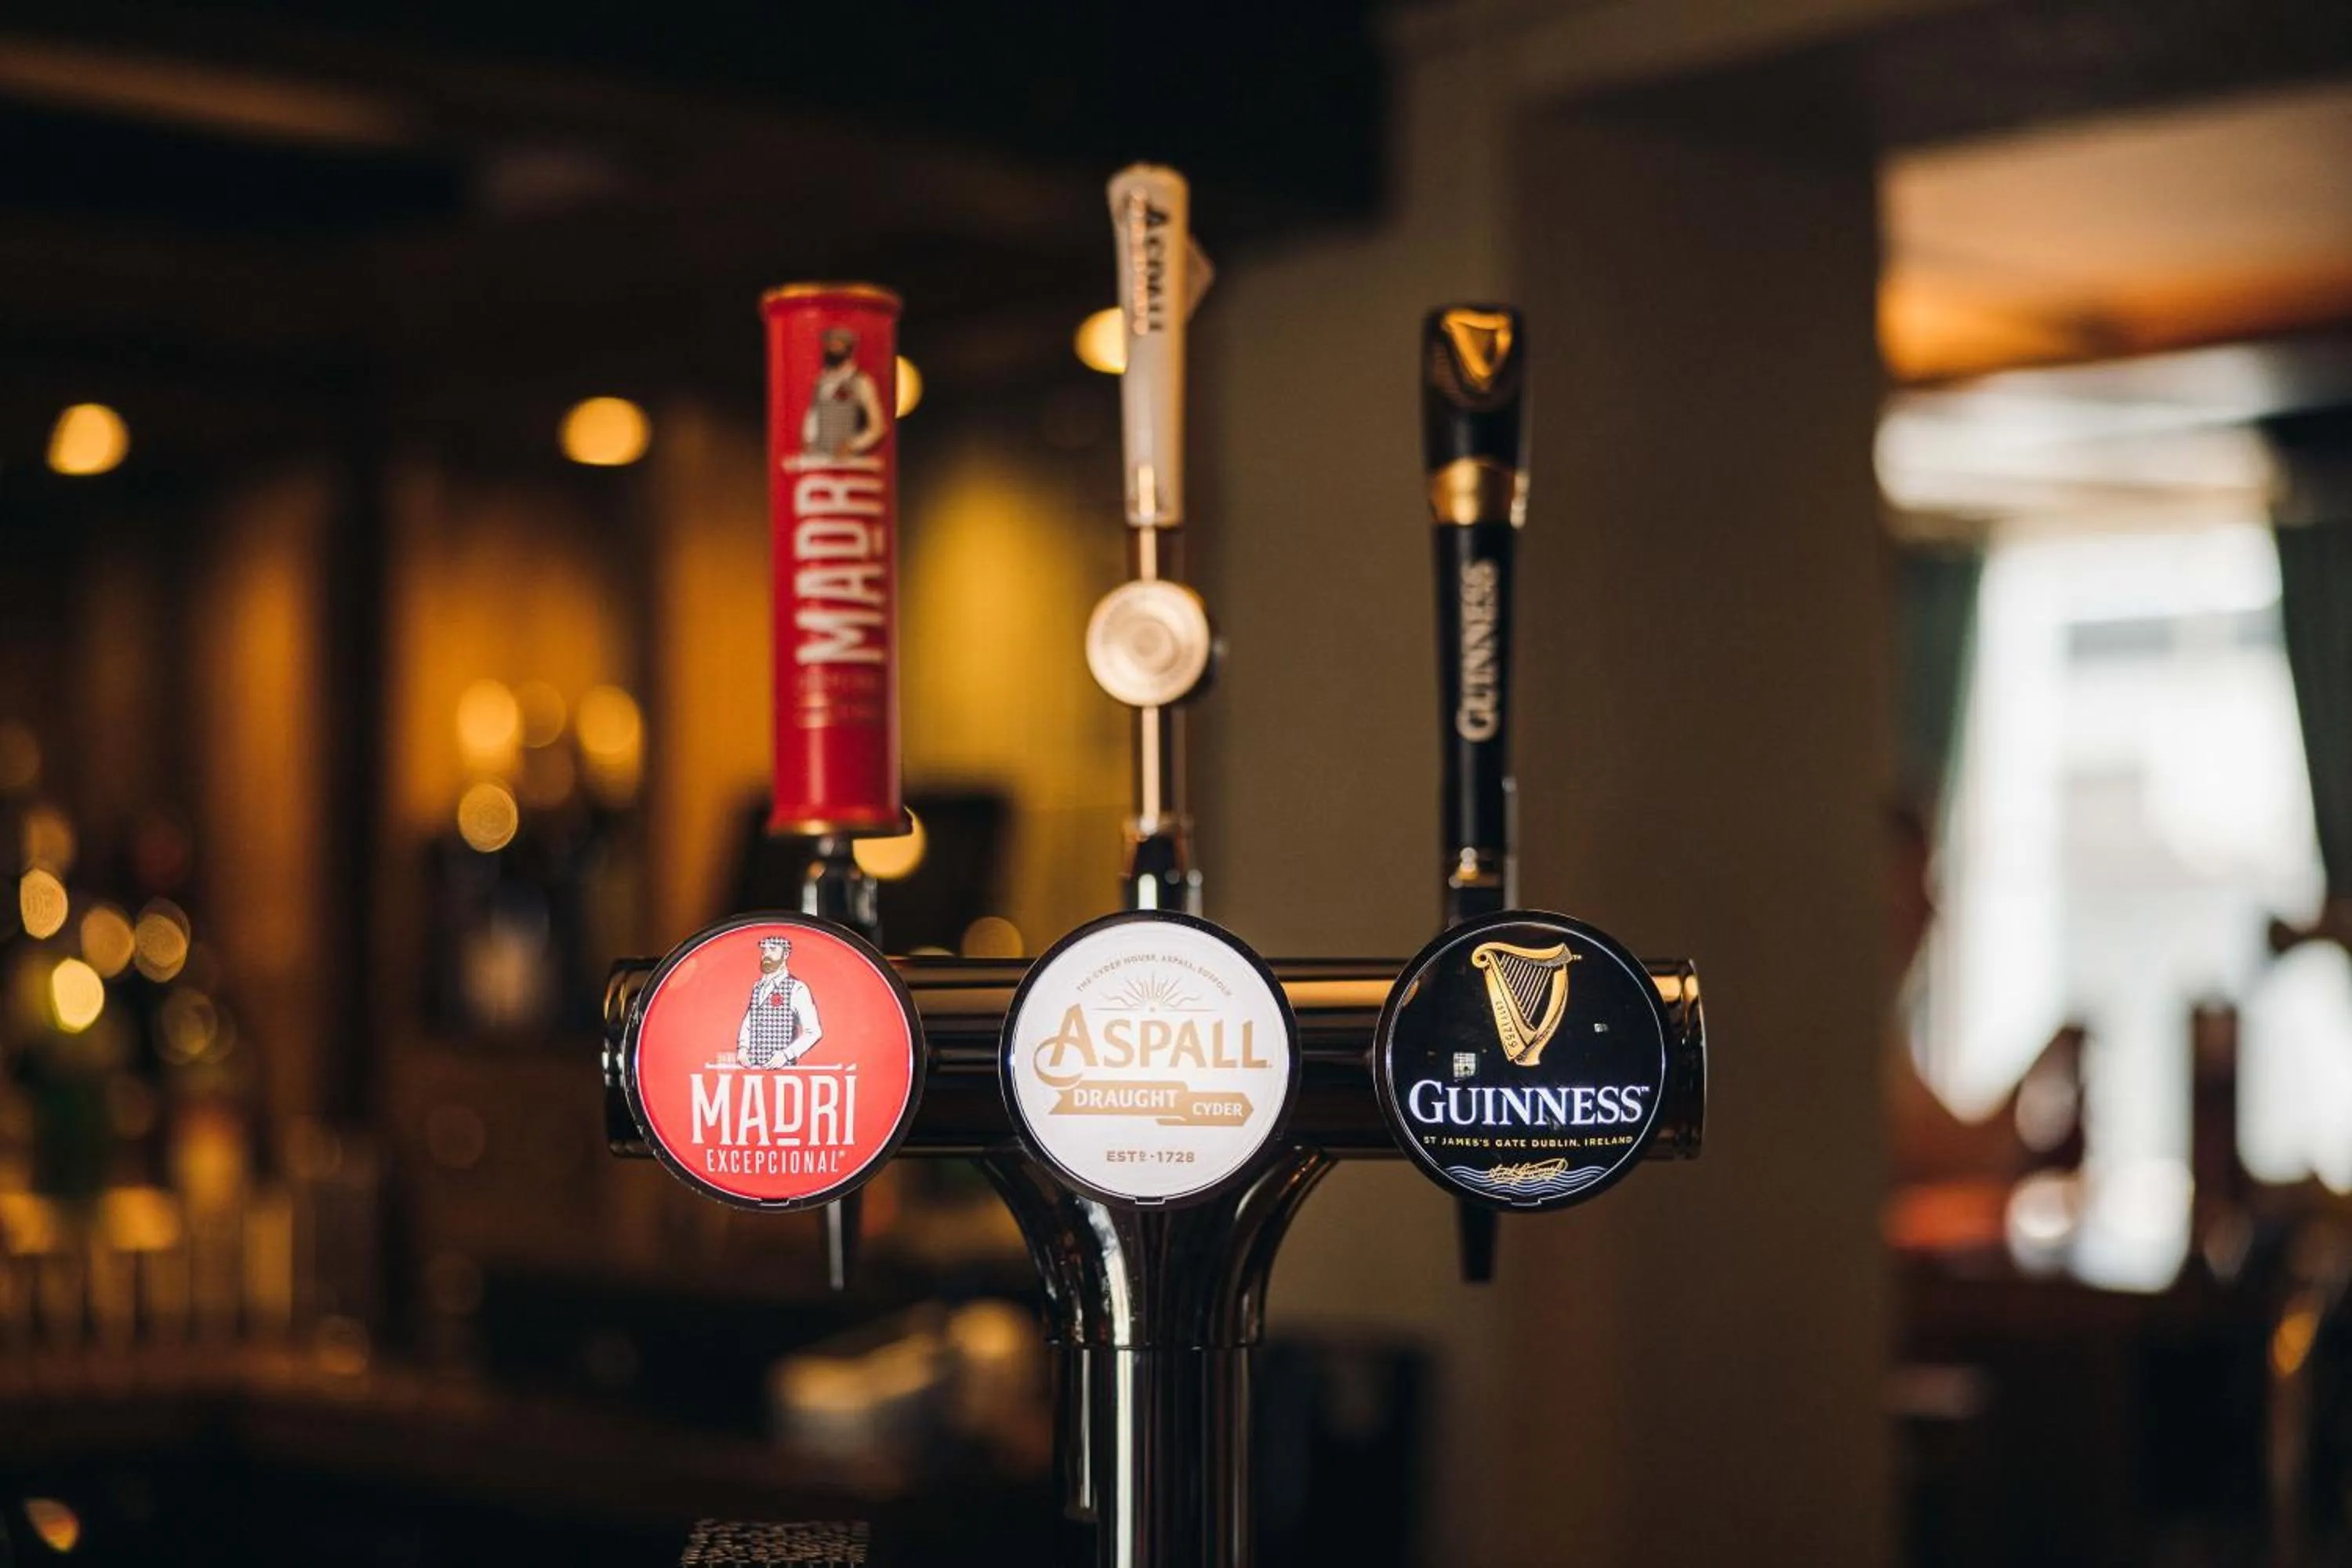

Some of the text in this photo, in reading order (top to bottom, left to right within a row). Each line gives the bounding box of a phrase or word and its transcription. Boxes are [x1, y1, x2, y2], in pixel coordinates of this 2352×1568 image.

[1033, 1003, 1269, 1088] ASPALL
[690, 1063, 858, 1146] MADRÍ
[1073, 1089, 1243, 1116] DRAUGHT CYDER
[1409, 1080, 1643, 1125] GUINNESS
[1424, 1136, 1436, 1145] ST
[1584, 1136, 1633, 1146] IRELAND
[706, 1149, 838, 1174] EXCEPCIONAL
[1157, 1150, 1196, 1163] 1728
